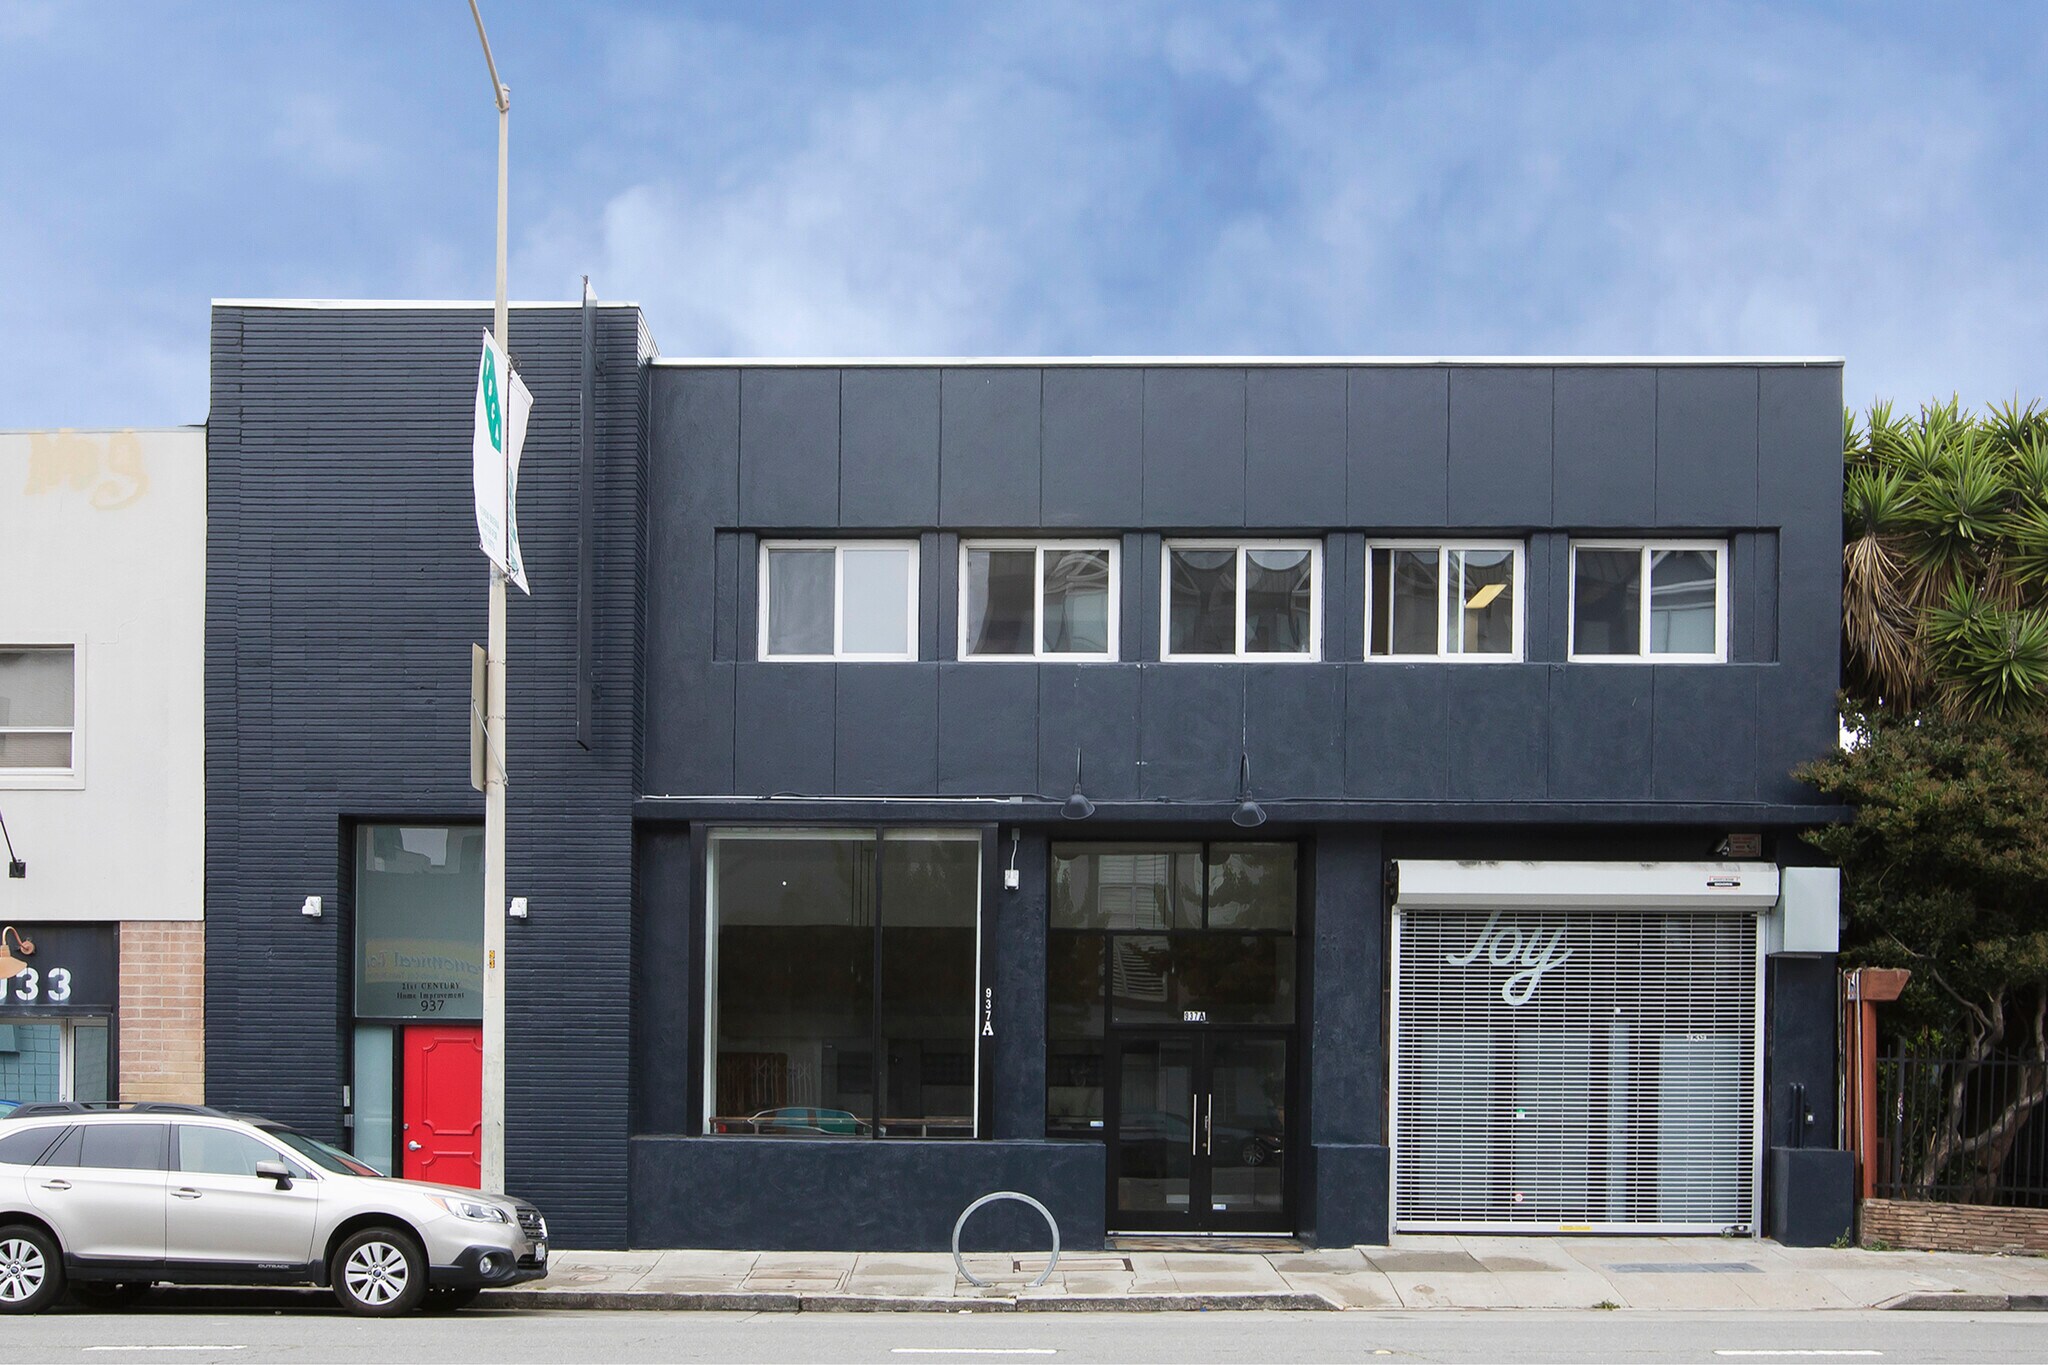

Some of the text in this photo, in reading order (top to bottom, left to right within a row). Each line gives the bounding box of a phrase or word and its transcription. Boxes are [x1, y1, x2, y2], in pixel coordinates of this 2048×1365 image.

[1445, 910, 1574, 1006] Joy
[0, 967, 72, 1001] 33
[421, 982, 460, 990] CENTURY
[396, 992, 465, 1001] Home Improvement
[420, 1000, 445, 1012] 937
[982, 987, 994, 1036] 937A
